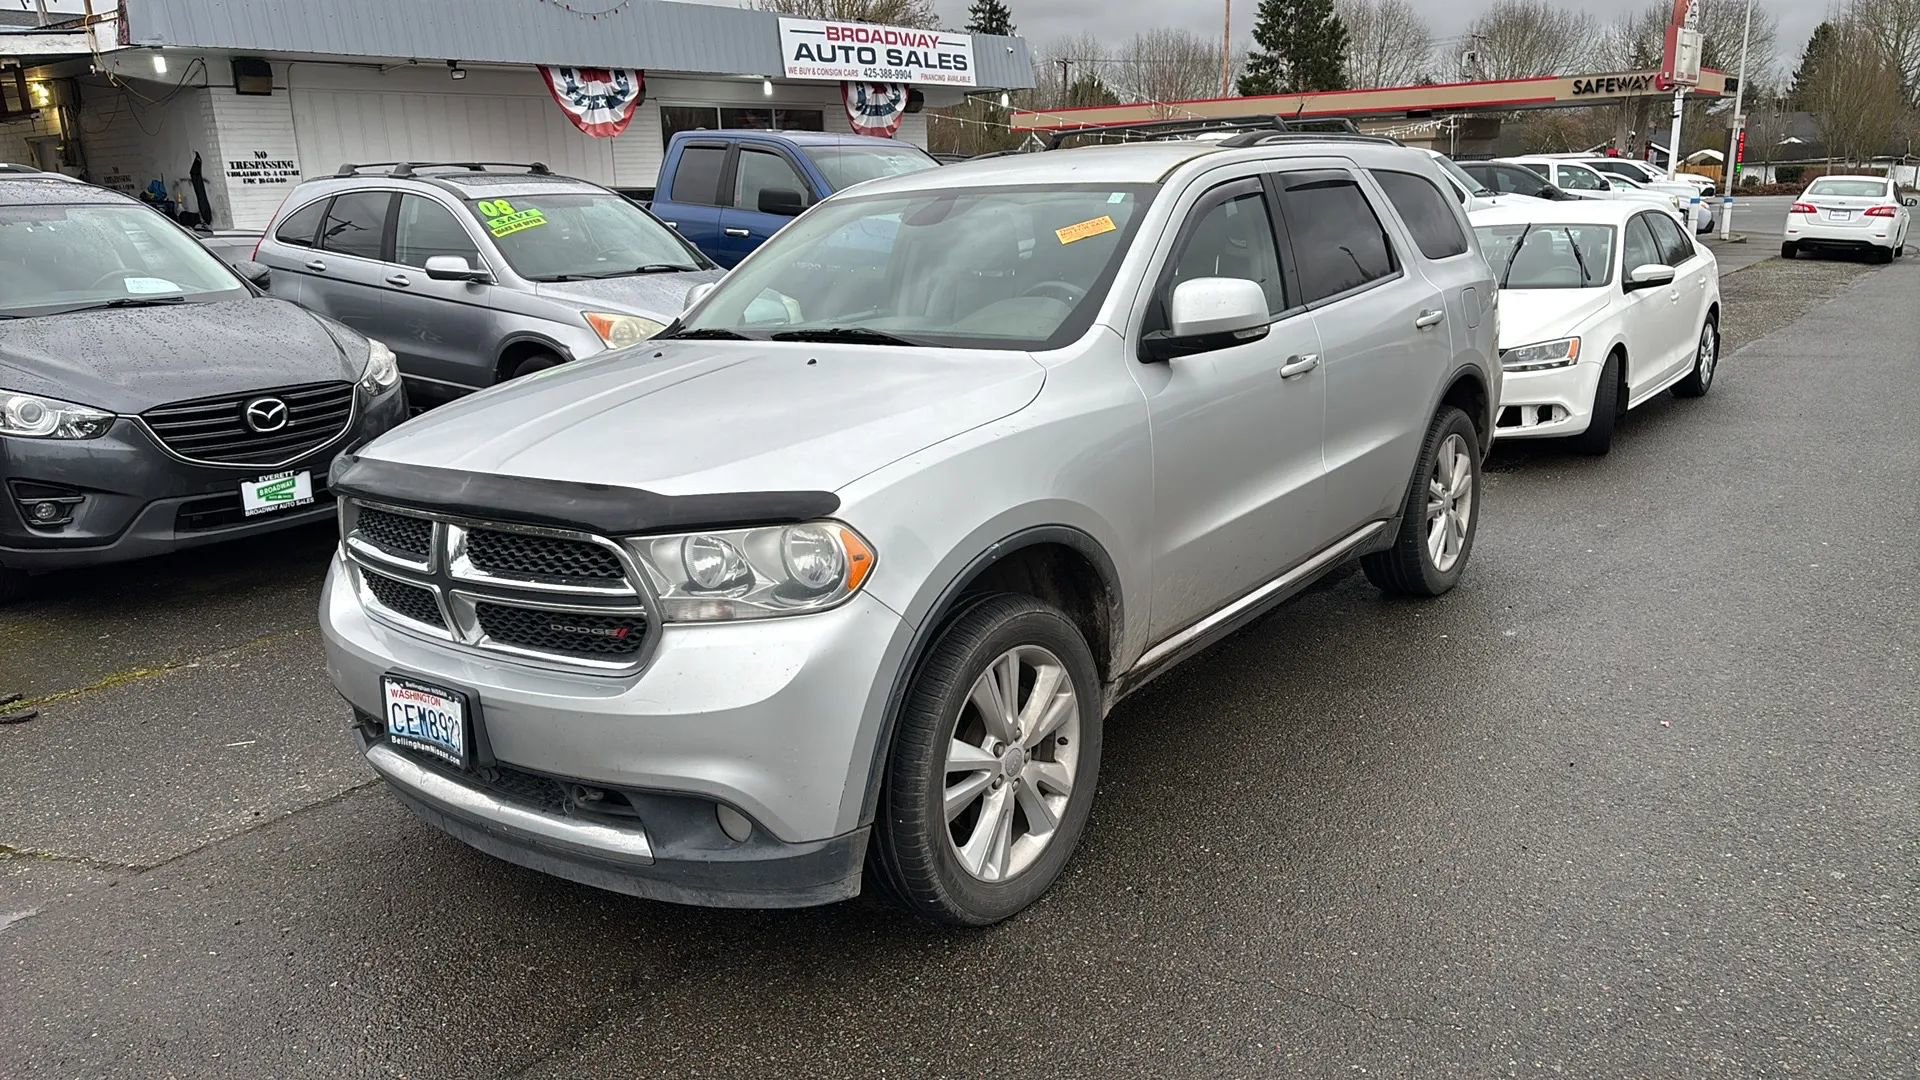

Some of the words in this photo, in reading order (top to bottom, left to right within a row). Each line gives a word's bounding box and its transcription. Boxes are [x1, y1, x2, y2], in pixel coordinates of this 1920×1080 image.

[825, 26, 940, 49] BROADWAY
[794, 43, 877, 65] AUTO
[886, 49, 968, 72] SALES
[788, 66, 797, 75] WE
[799, 67, 811, 76] BUY
[816, 68, 842, 77] CONSIGN
[843, 69, 859, 78] CARS
[863, 67, 912, 80] 425-388-9904
[920, 73, 945, 81] FINANCING
[947, 74, 971, 83] AVAILABLE
[1572, 74, 1654, 95] SAFEWAY
[253, 150, 268, 159] NO
[229, 160, 294, 170] TRESPASSING
[478, 199, 516, 217] 08
[495, 211, 533, 225] SAVE
[495, 225, 514, 235] MAKE
[522, 217, 542, 226] OFFER
[258, 470, 295, 482] EVERETT
[259, 480, 293, 496] BROADWAY
[245, 505, 278, 517] BROADWAY
[279, 501, 295, 510] AUTO
[296, 497, 315, 506] SALES
[550, 624, 617, 637] DODGE
[390, 688, 441, 707] WASHINGTON
[391, 702, 461, 752] CEM8923
[391, 735, 461, 766] BellinghamNissan.com
